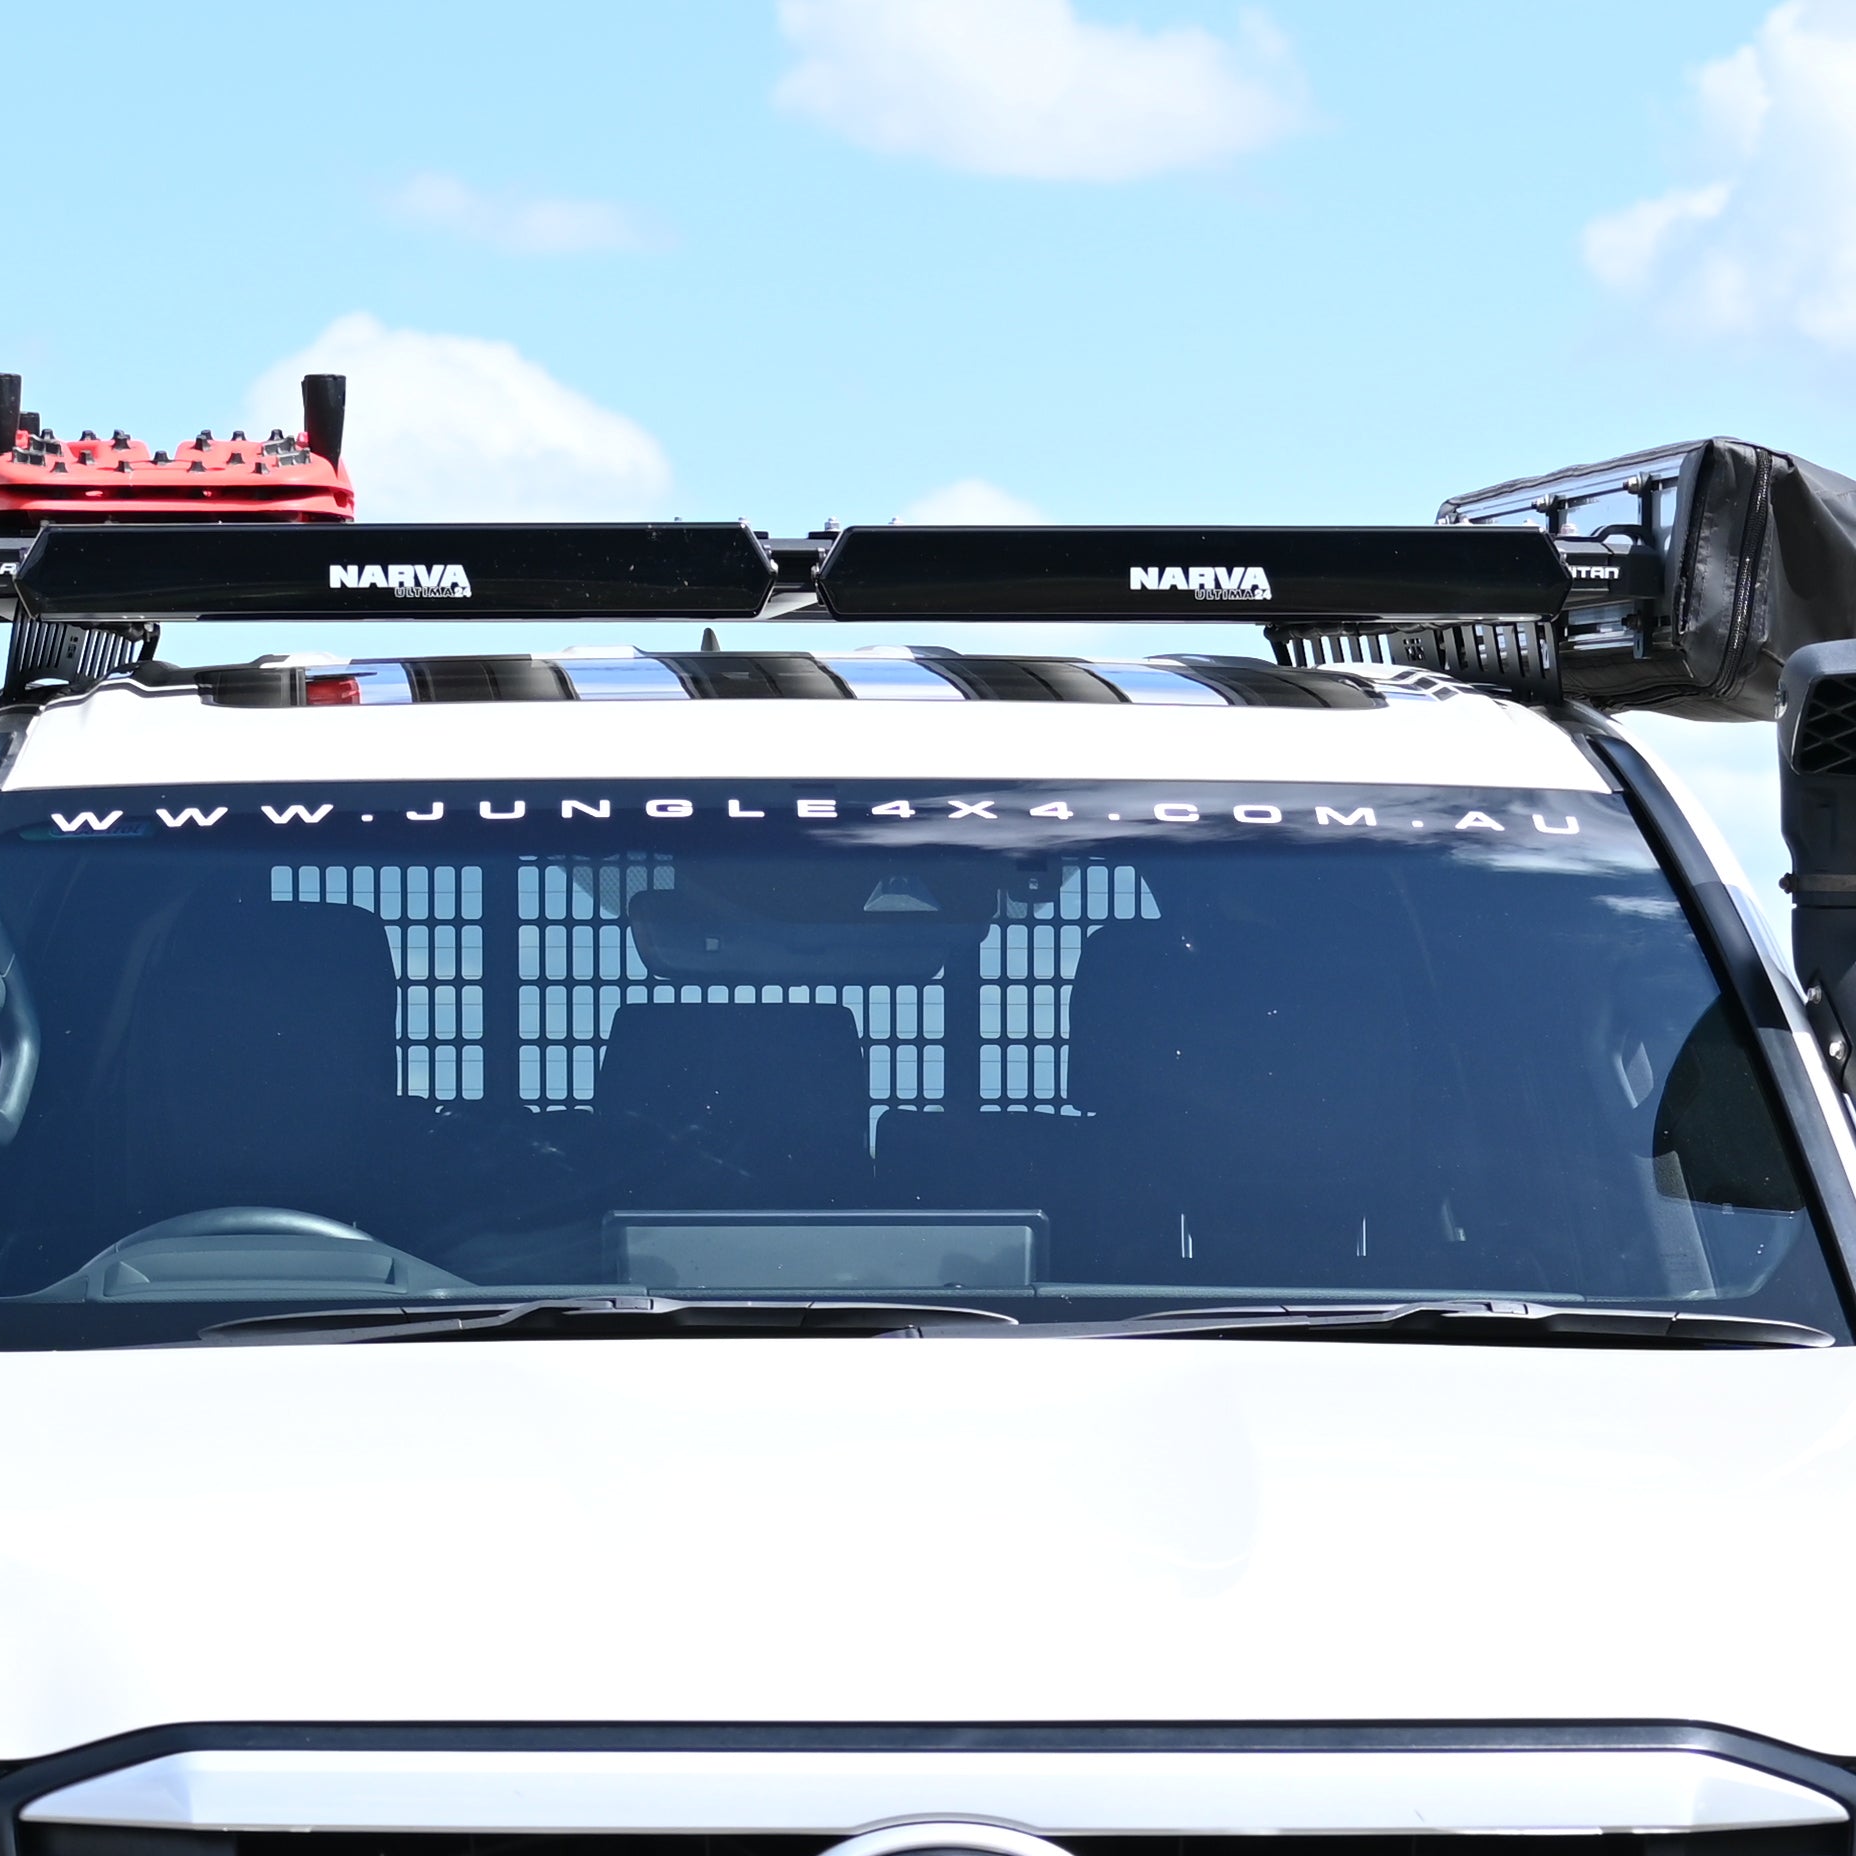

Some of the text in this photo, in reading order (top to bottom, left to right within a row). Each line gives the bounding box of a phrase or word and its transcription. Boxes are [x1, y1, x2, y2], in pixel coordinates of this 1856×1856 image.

[329, 564, 470, 589] NARVA
[1129, 566, 1270, 590] NARVA
[1568, 566, 1620, 579] ITAN
